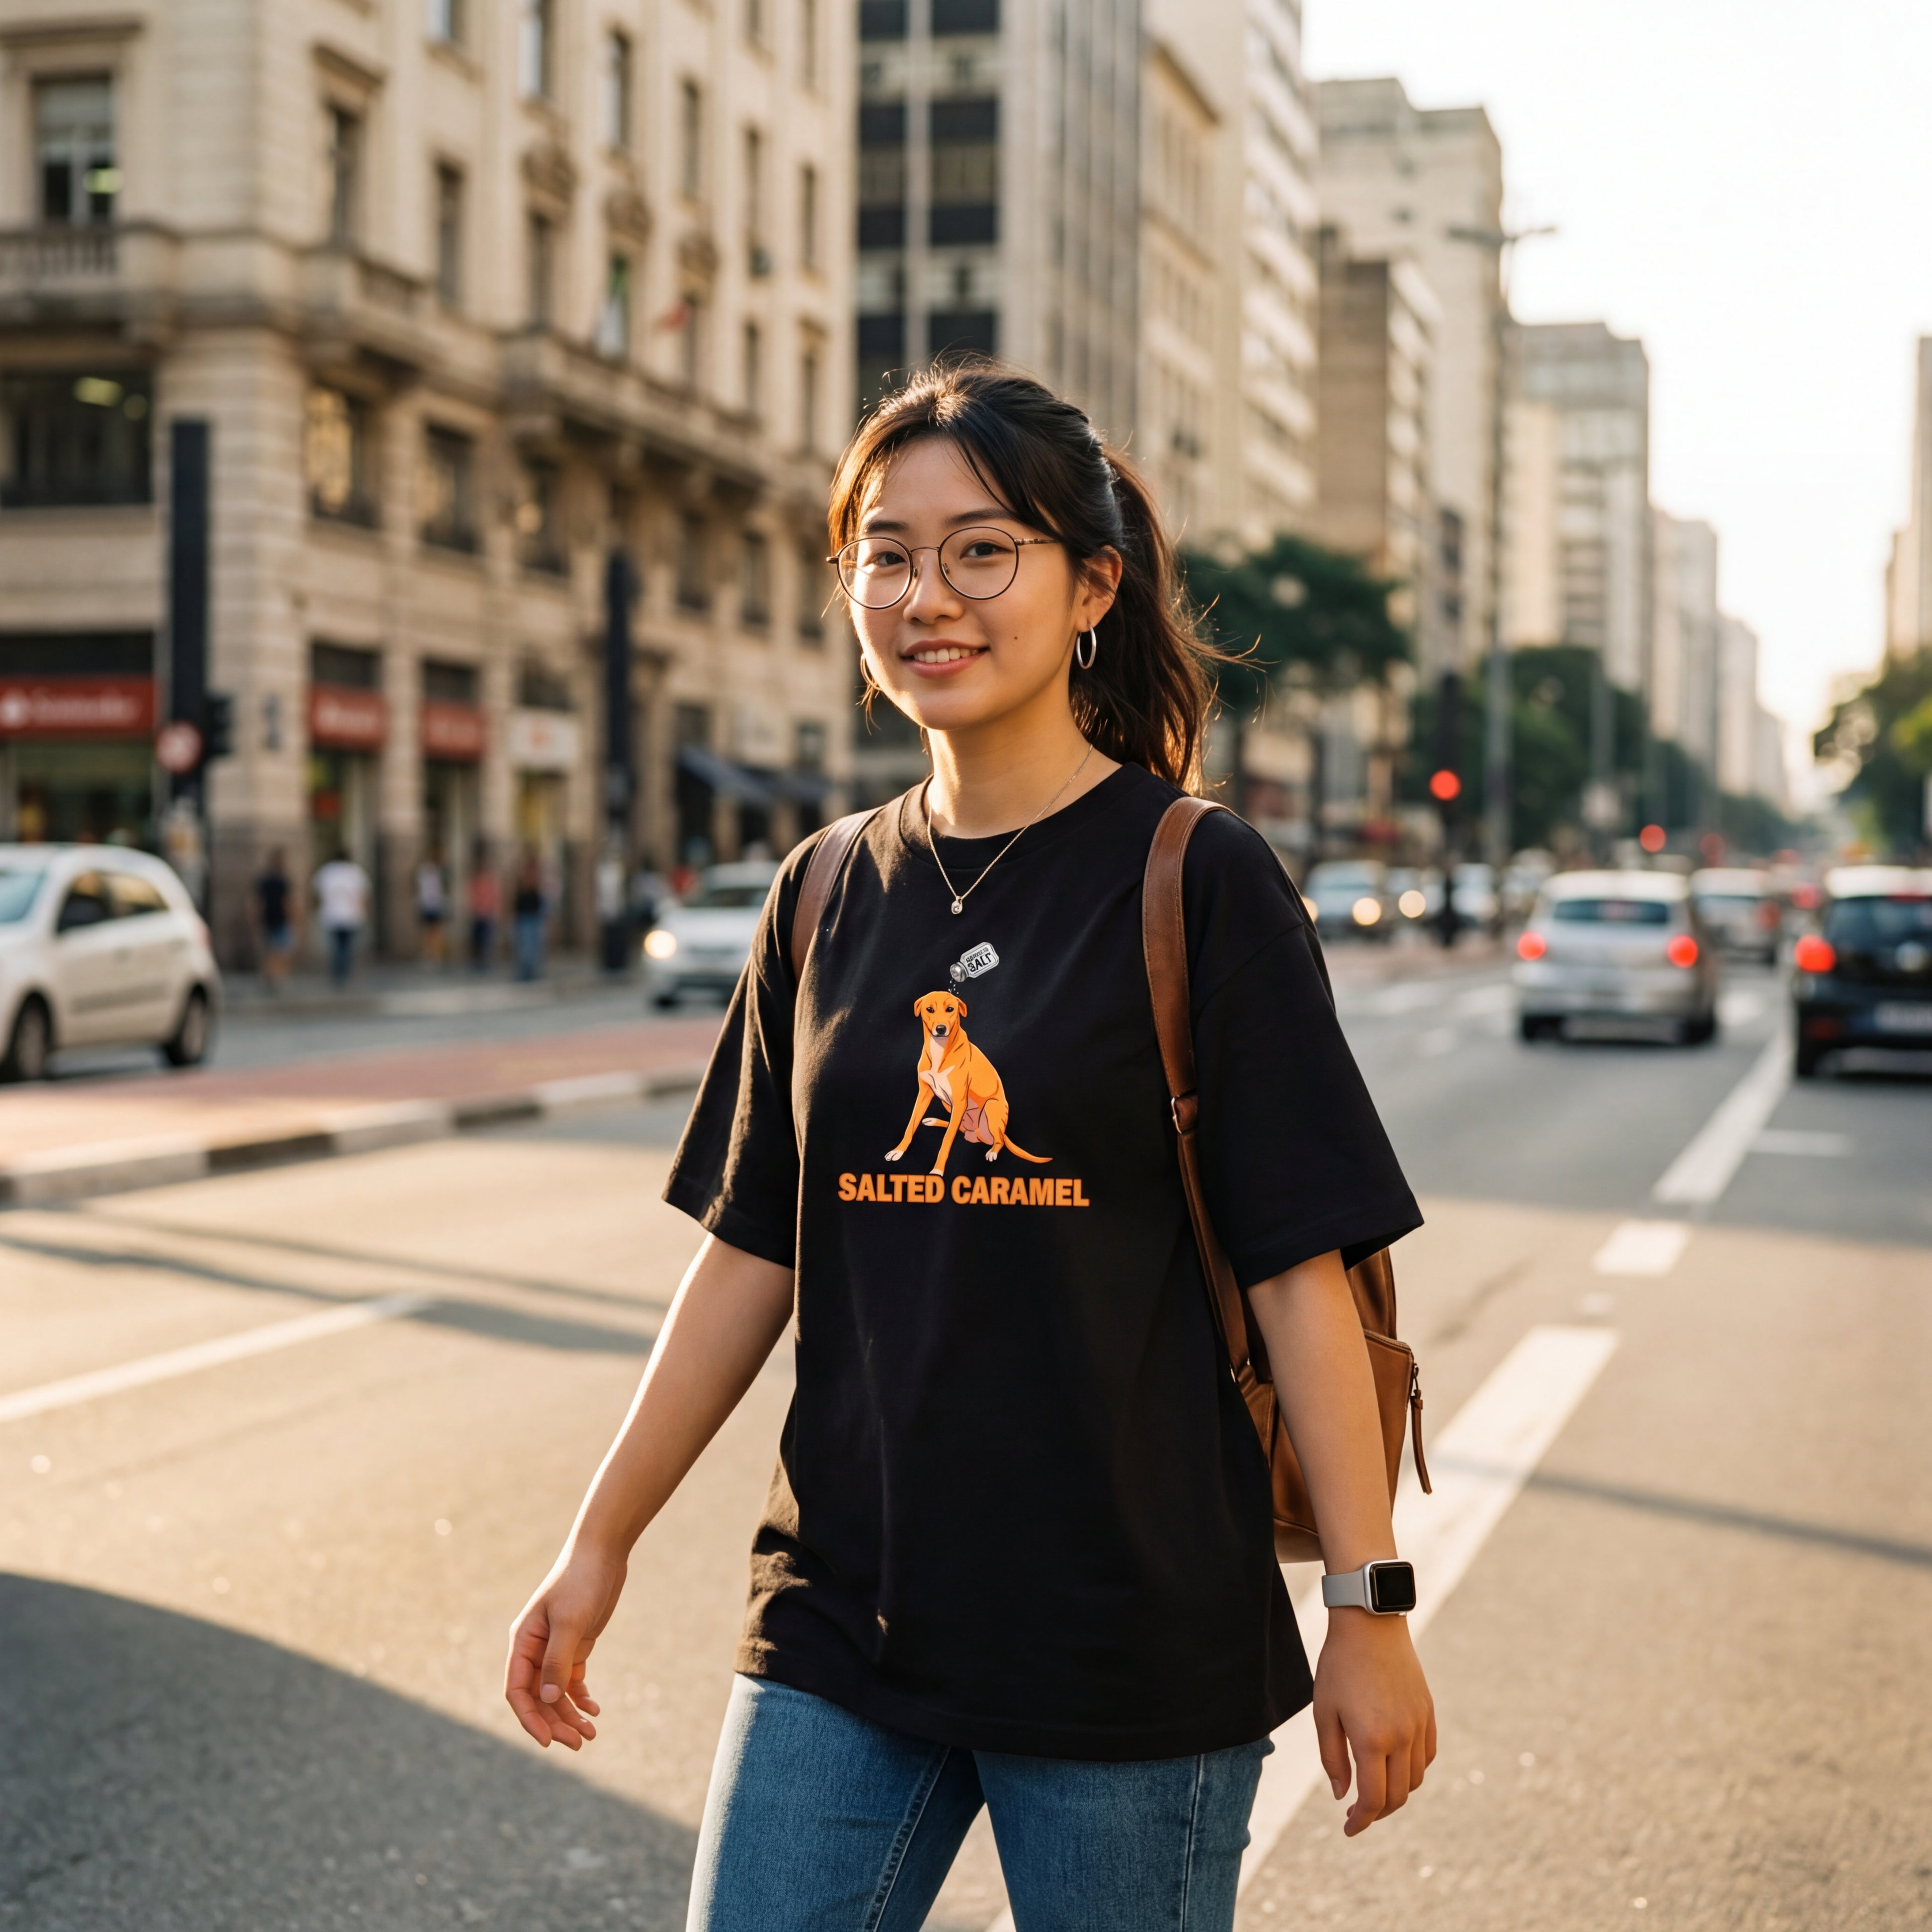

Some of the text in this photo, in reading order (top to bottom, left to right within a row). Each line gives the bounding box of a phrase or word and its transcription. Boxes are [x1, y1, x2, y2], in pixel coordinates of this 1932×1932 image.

[968, 952, 991, 972] SALT
[838, 1173, 1089, 1206] SALTED CARAMEL
